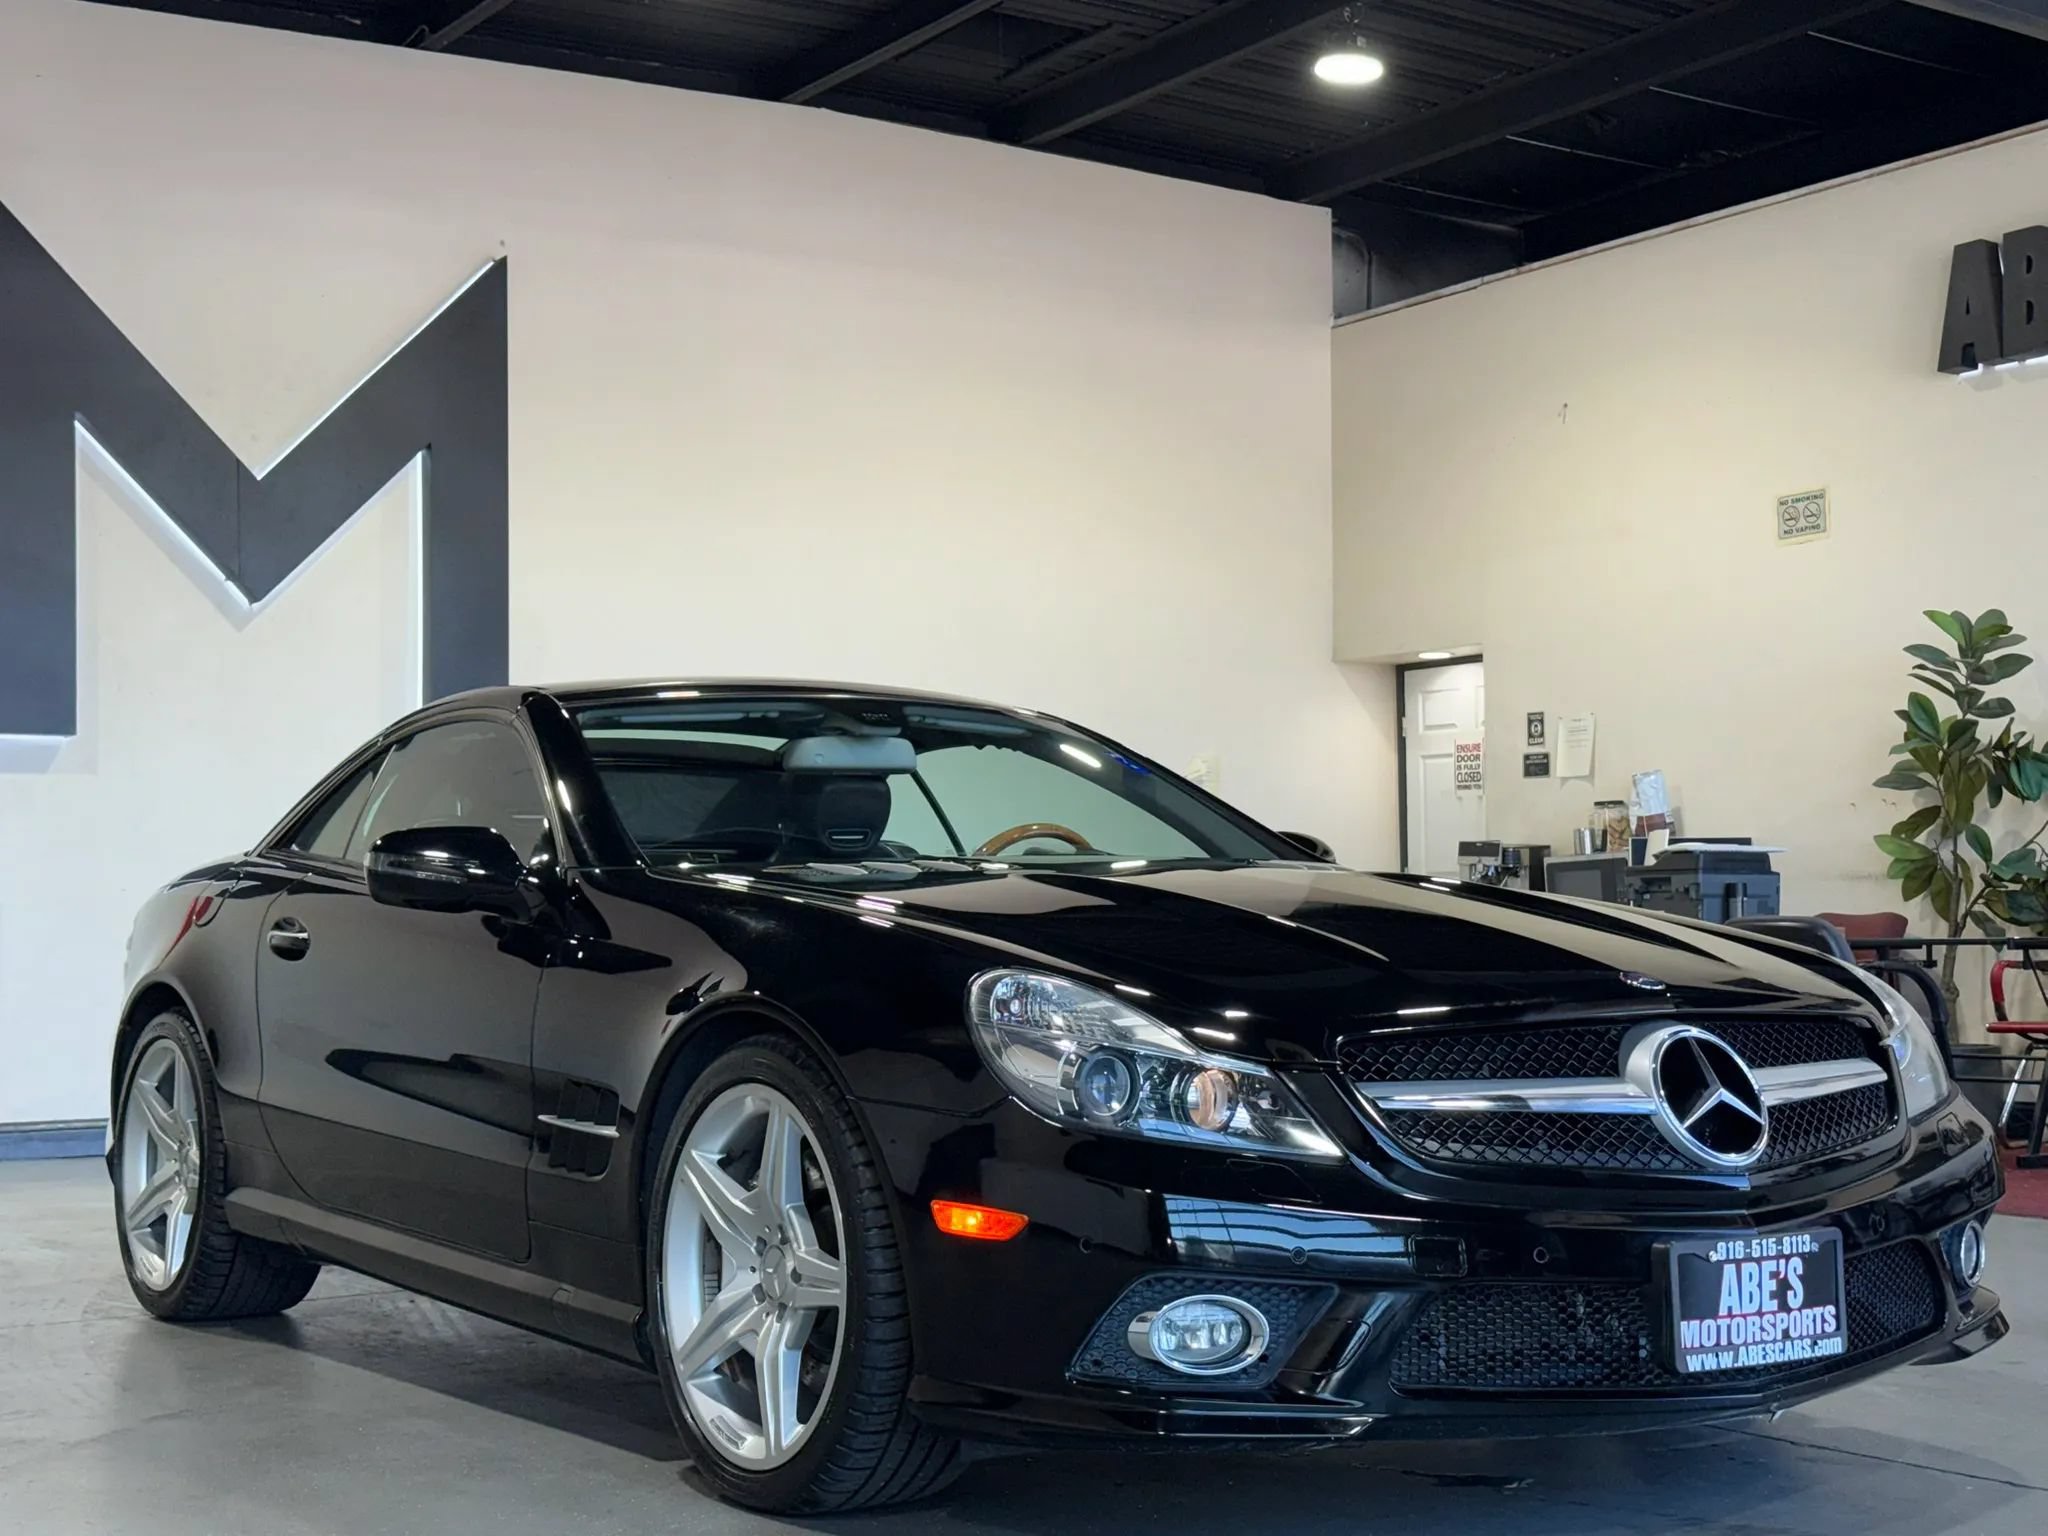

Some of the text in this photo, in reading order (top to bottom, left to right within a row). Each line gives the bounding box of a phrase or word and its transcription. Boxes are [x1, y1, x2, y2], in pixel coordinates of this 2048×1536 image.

[0, 203, 510, 737] M
[1791, 493, 1824, 504] SMOKING
[1795, 523, 1821, 533] VAPING
[1456, 743, 1481, 753] ENSURE
[1456, 754, 1481, 763] DOOR
[1456, 771, 1482, 783] CLOSED
[1718, 1256, 1804, 1316] ABE'S
[1680, 1305, 1837, 1349] MOTORSPORTS
